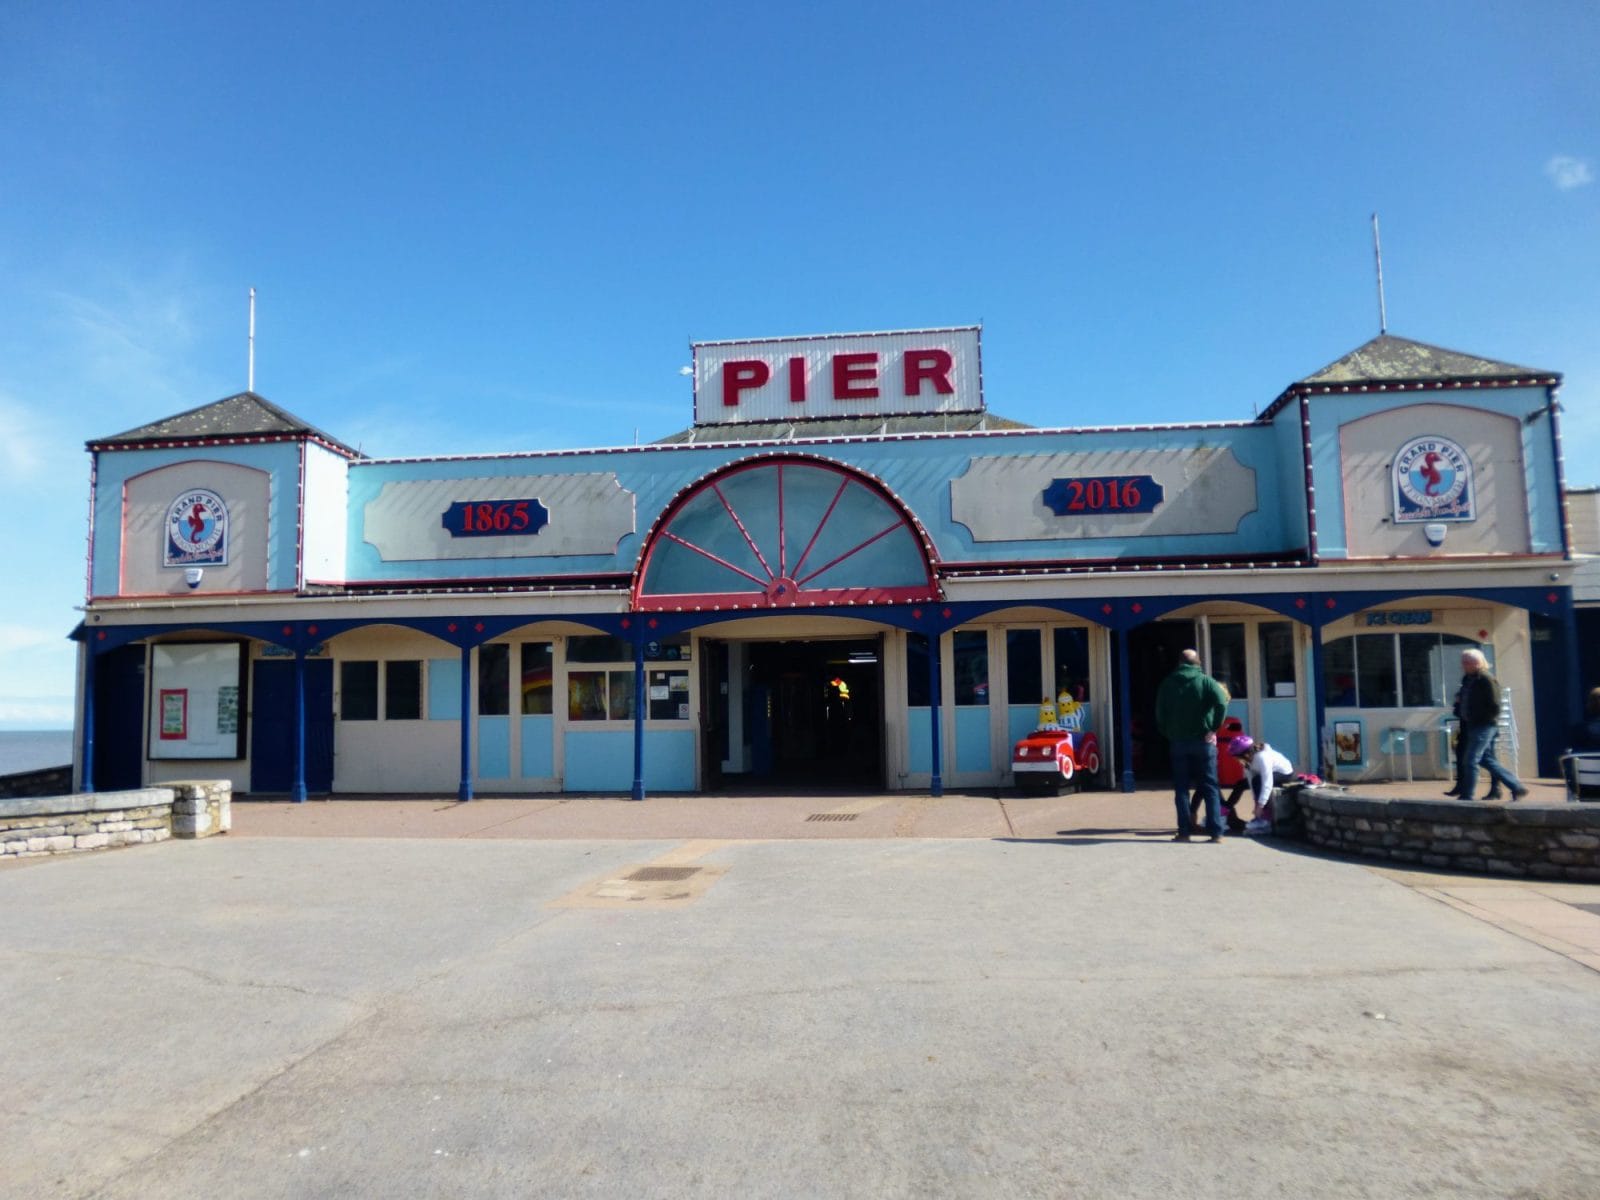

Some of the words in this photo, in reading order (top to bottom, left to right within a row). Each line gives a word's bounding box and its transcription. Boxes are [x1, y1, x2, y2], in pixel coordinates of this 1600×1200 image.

[722, 349, 955, 406] PIER
[1399, 443, 1436, 474] GRAND
[1441, 446, 1464, 472] PIER
[172, 495, 202, 524] GRAND
[206, 499, 222, 521] PIER
[1067, 479, 1141, 510] 2016
[463, 502, 529, 532] 1865
